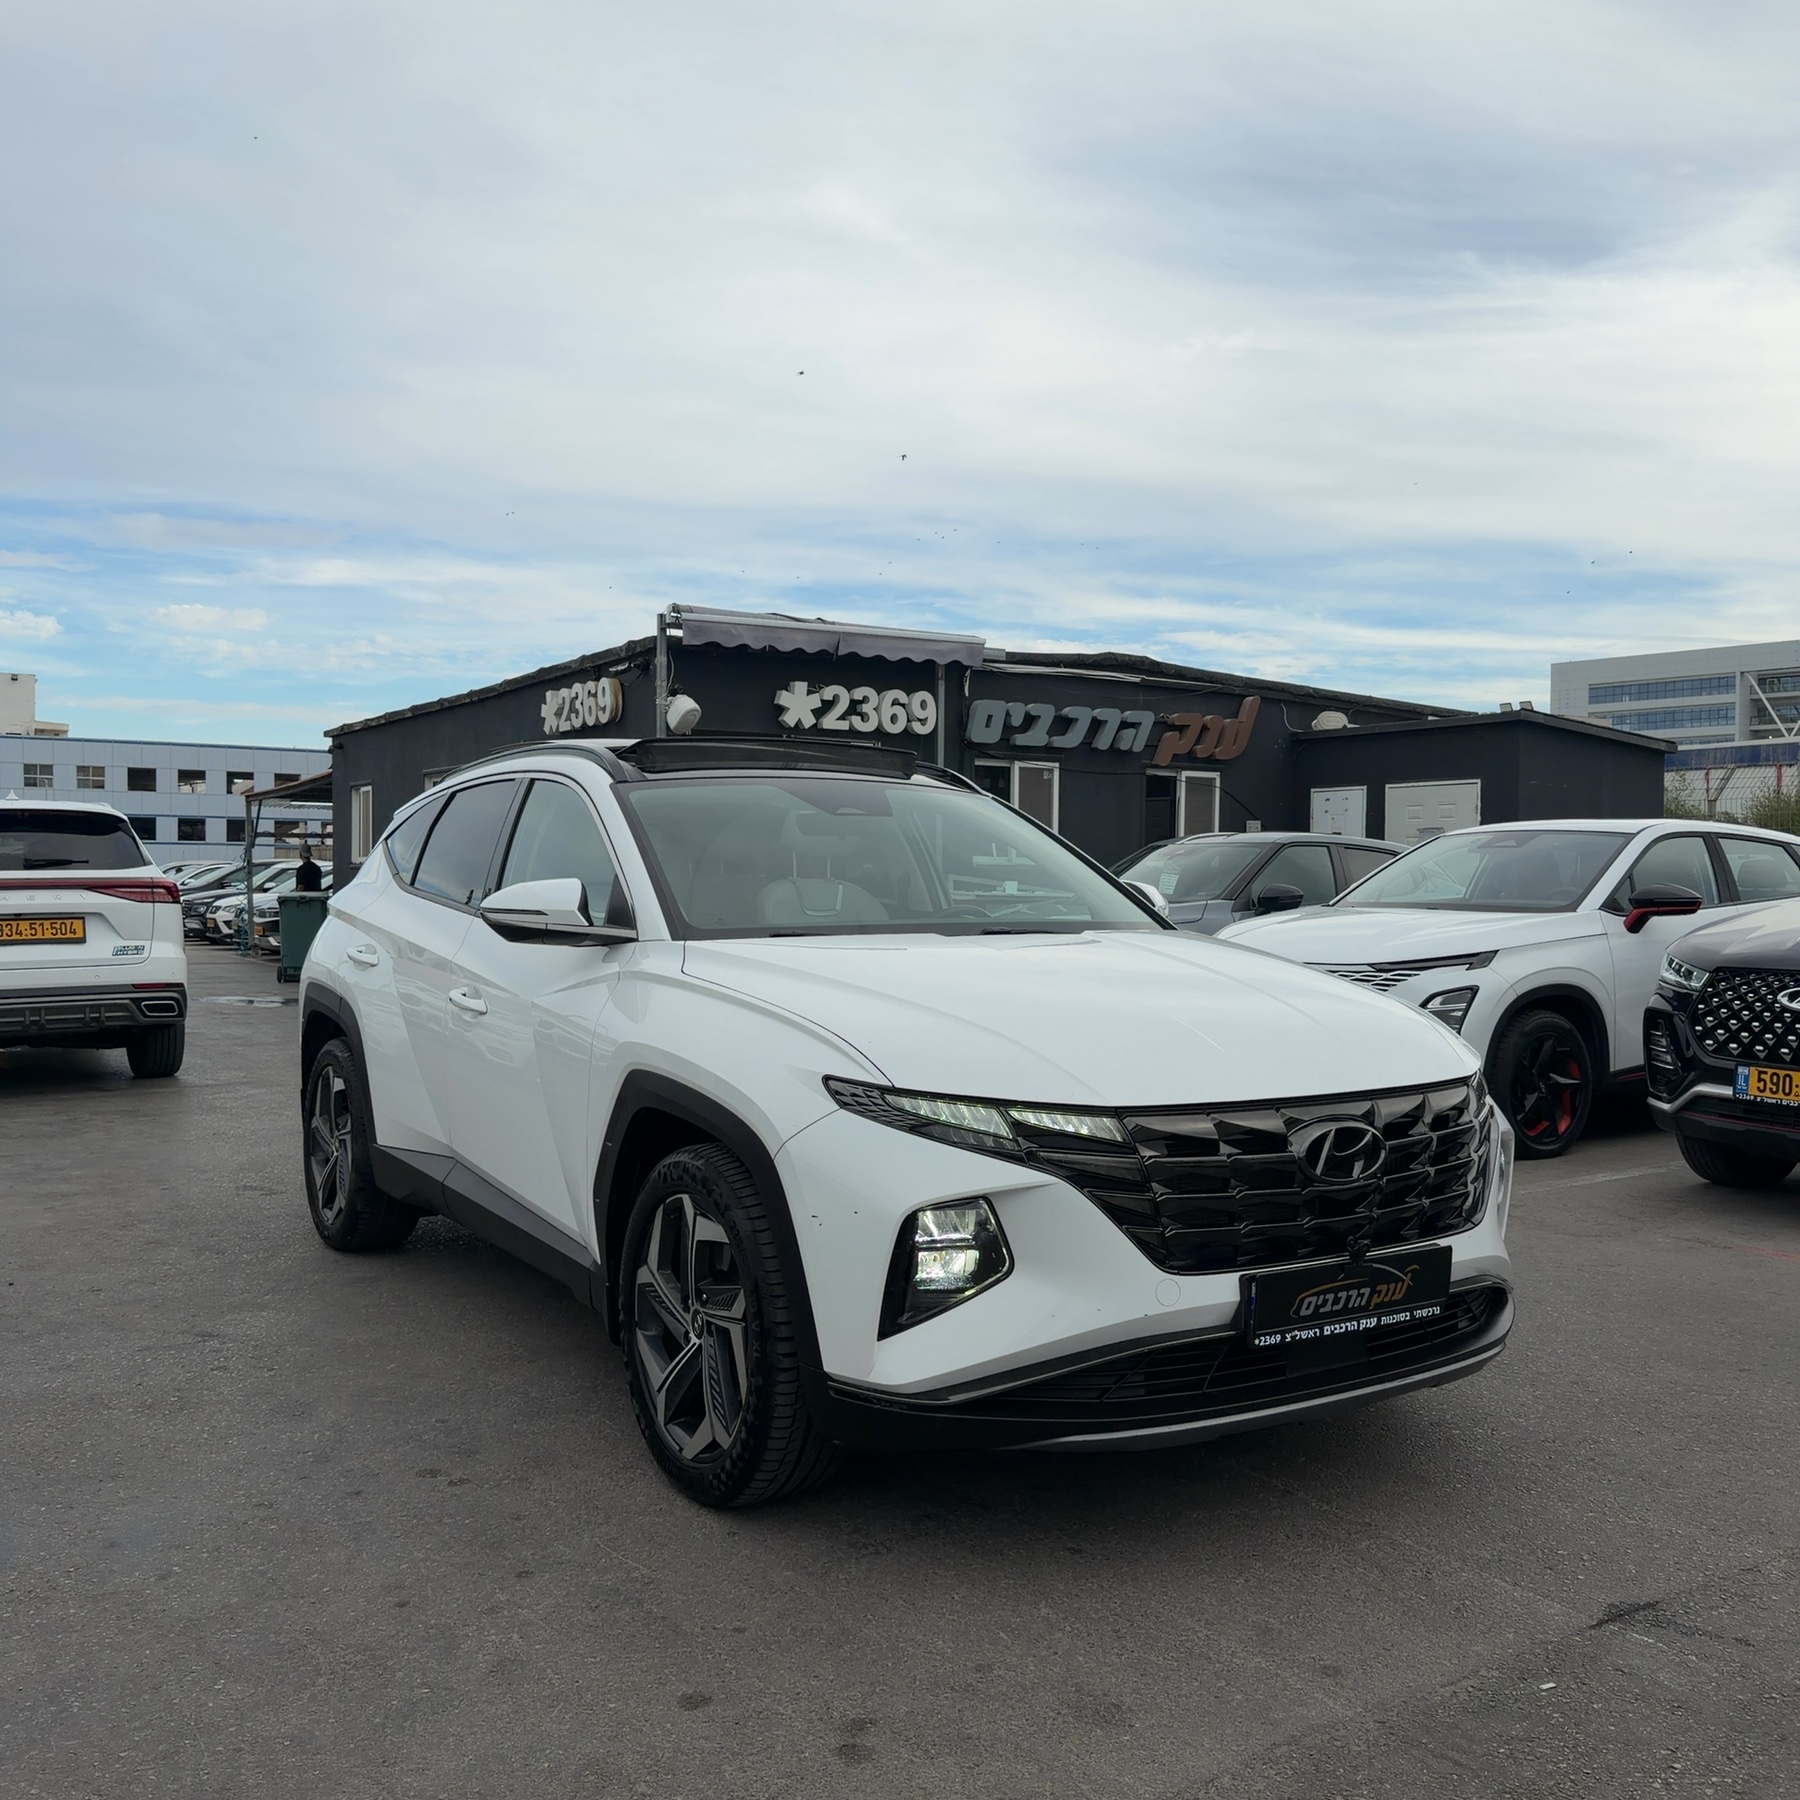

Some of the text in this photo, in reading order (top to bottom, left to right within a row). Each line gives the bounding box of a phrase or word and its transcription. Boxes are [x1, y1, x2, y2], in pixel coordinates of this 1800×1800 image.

[968, 695, 1261, 766] ענק הרכבים
[1300, 1271, 1413, 1316] ענק הרכבים
[1381, 1312, 1410, 1325] בסוכנות
[1413, 1306, 1440, 1319] נרכשתי
[1323, 1321, 1358, 1336] הרכבים
[1359, 1317, 1378, 1331] ענק
